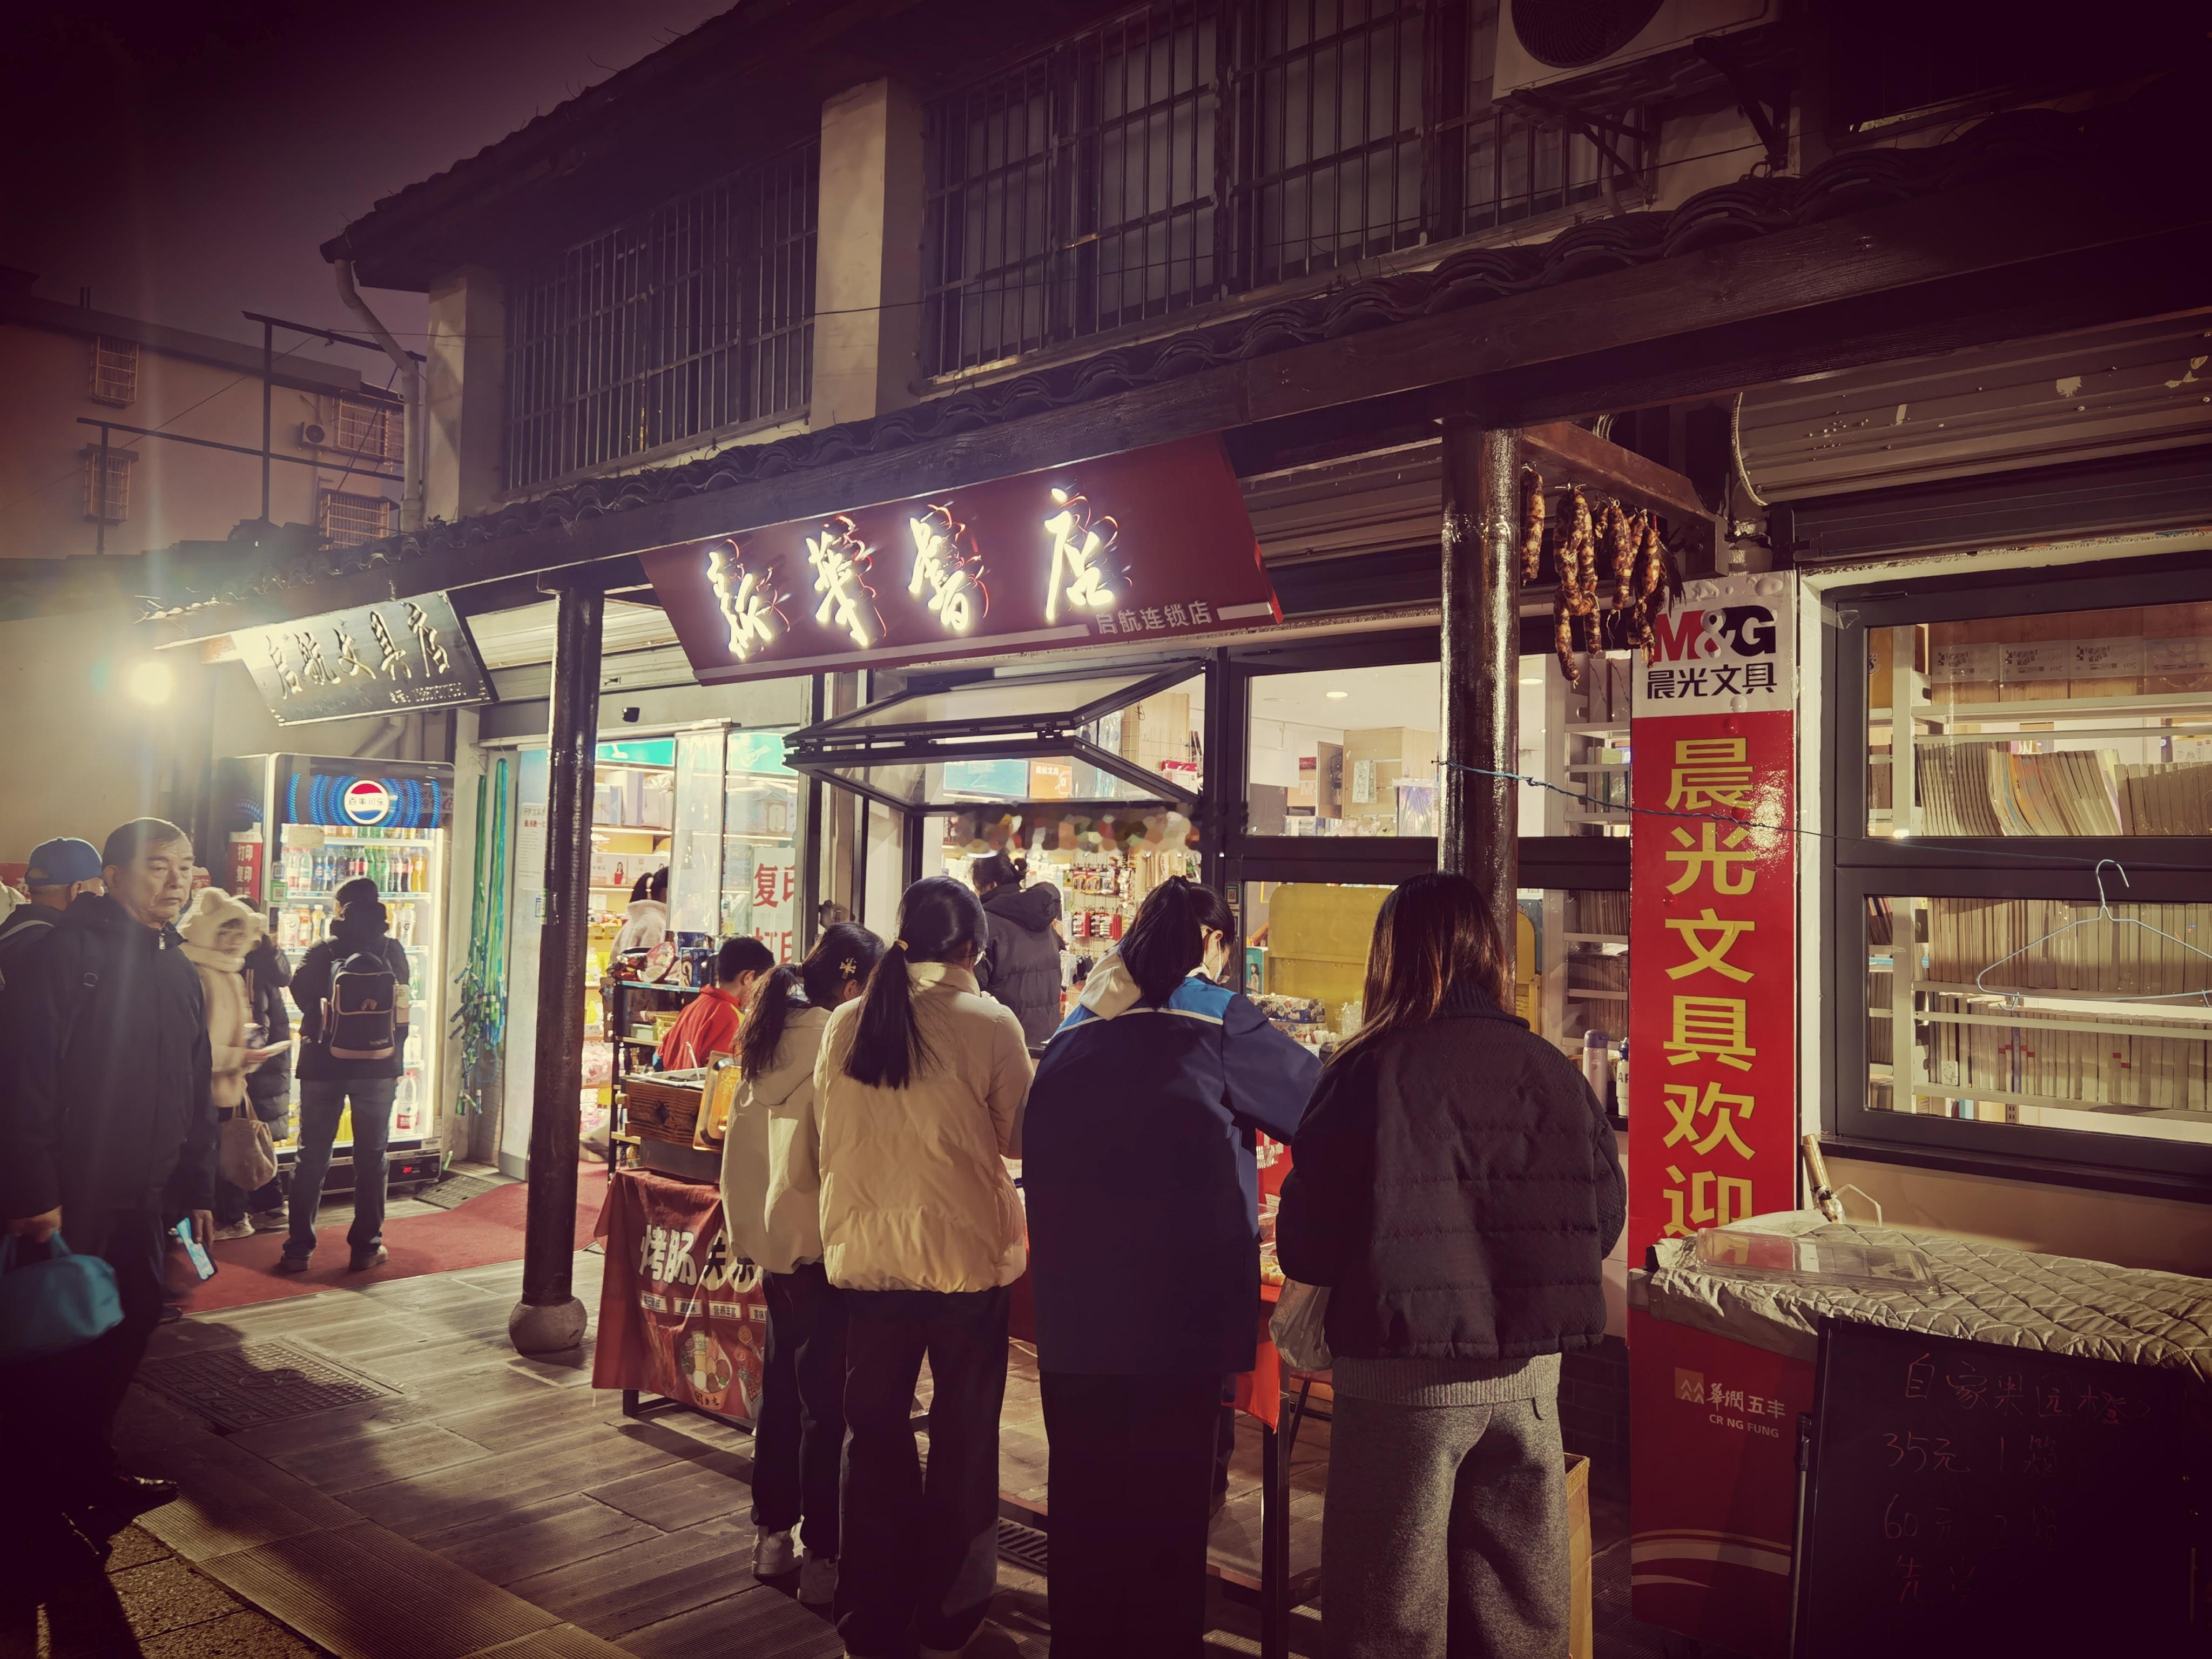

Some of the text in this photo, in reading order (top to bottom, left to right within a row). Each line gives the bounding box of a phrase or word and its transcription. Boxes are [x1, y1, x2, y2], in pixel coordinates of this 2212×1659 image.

[1096, 600, 1213, 635] 启航连锁店
[1654, 605, 1776, 662] M&G
[1647, 662, 1777, 699] 晨光文具
[349, 797, 385, 806] 百事可乐
[238, 845, 253, 861] 打印
[237, 866, 253, 883] 复印
[1663, 738, 1757, 1237] 晨光文具欢迎
[713, 1305, 736, 1318] 营养丰富
[754, 1309, 767, 1320] 美味
[1709, 1414, 1779, 1438] CR NG FUNG
